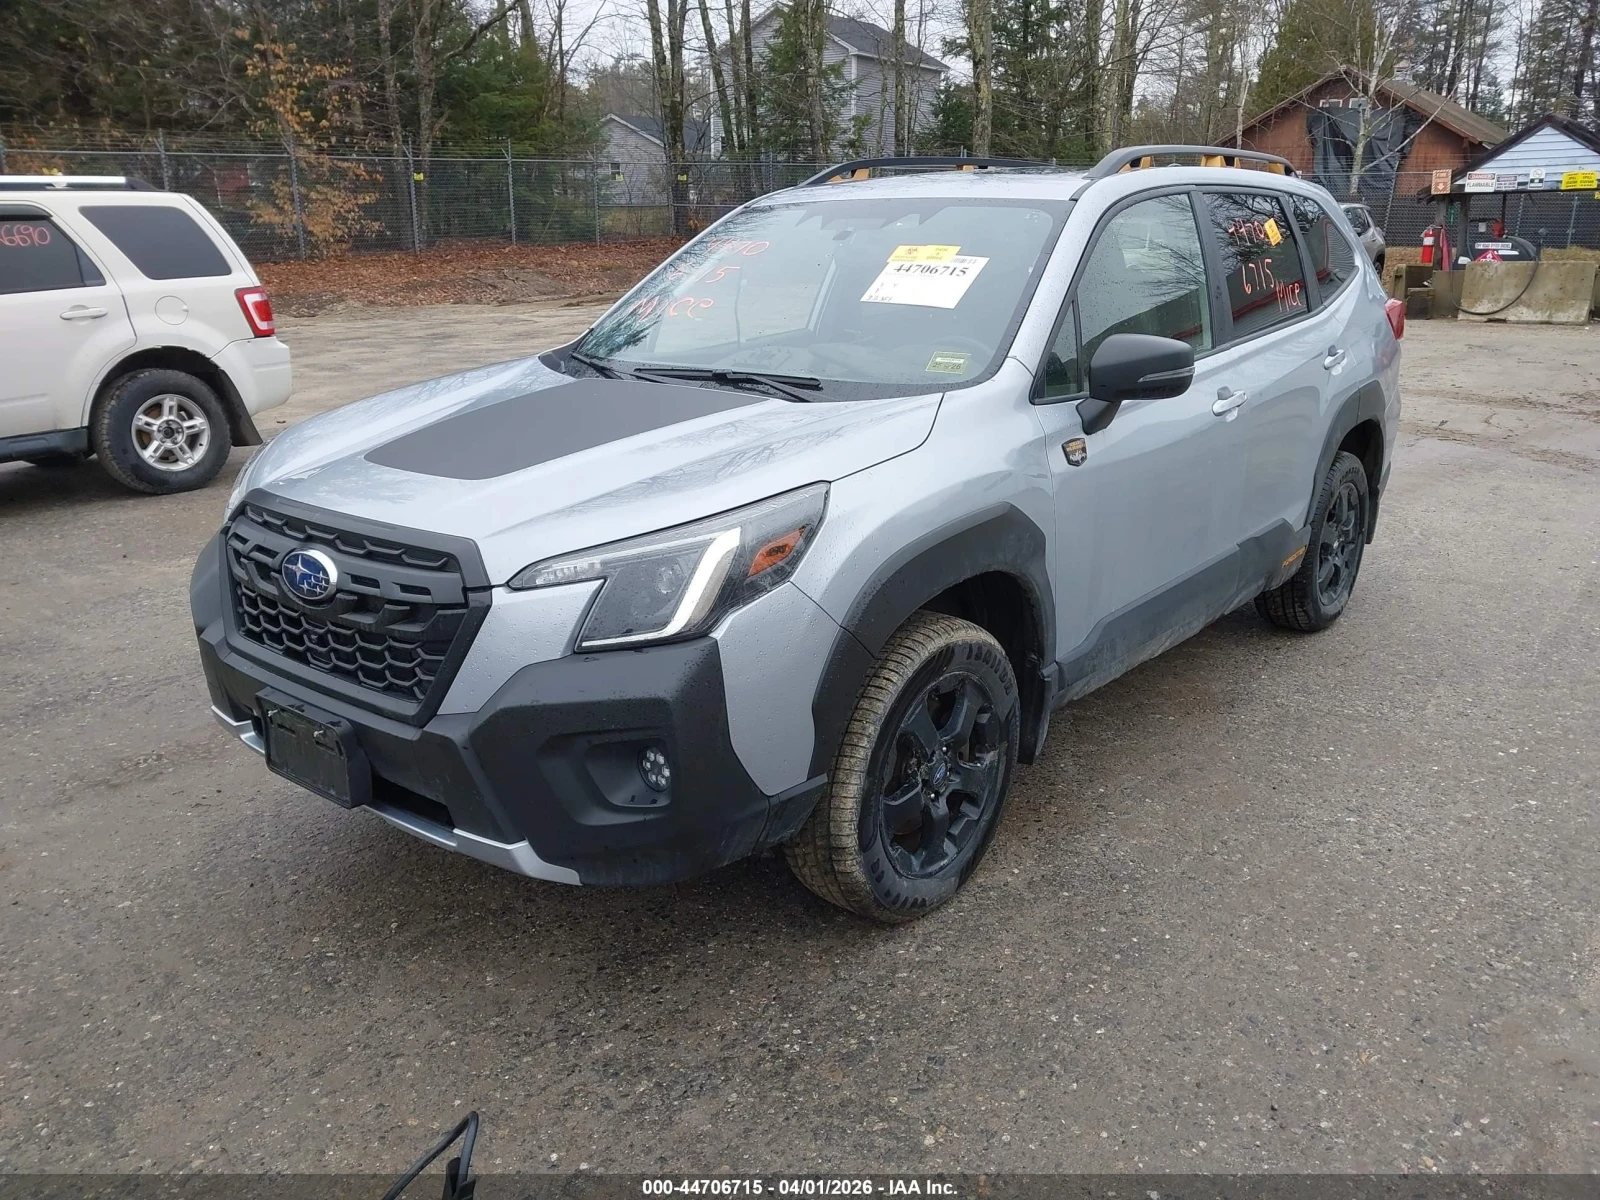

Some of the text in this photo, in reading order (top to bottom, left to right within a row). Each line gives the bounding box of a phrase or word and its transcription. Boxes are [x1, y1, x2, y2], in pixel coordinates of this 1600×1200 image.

[0, 224, 50, 246] 6690
[894, 263, 970, 277] 44706715
[1242, 258, 1274, 294] 6715
